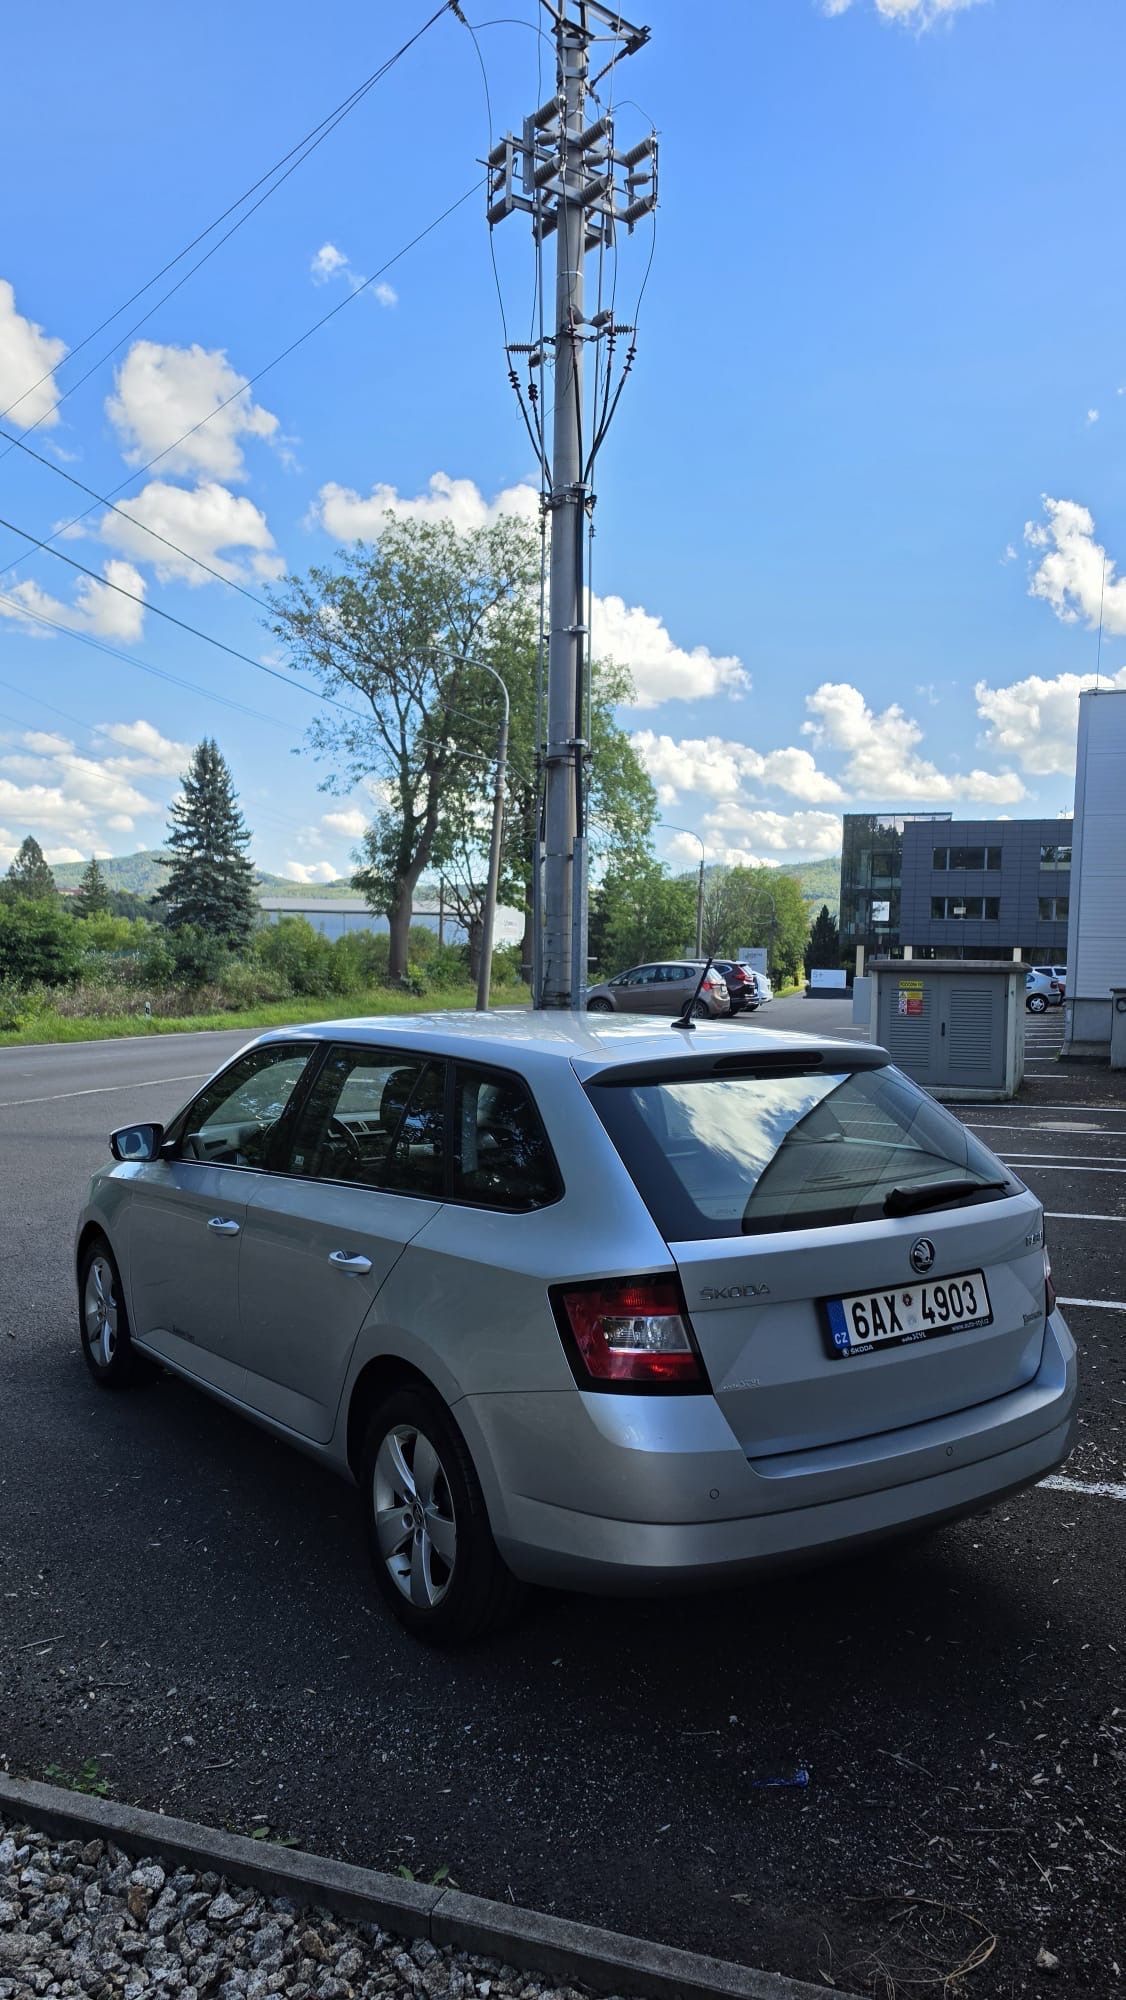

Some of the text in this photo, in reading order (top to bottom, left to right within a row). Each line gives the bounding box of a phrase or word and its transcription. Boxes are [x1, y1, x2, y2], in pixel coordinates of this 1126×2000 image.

[851, 1280, 977, 1339] 6AX 4903
[834, 1331, 849, 1345] CZ
